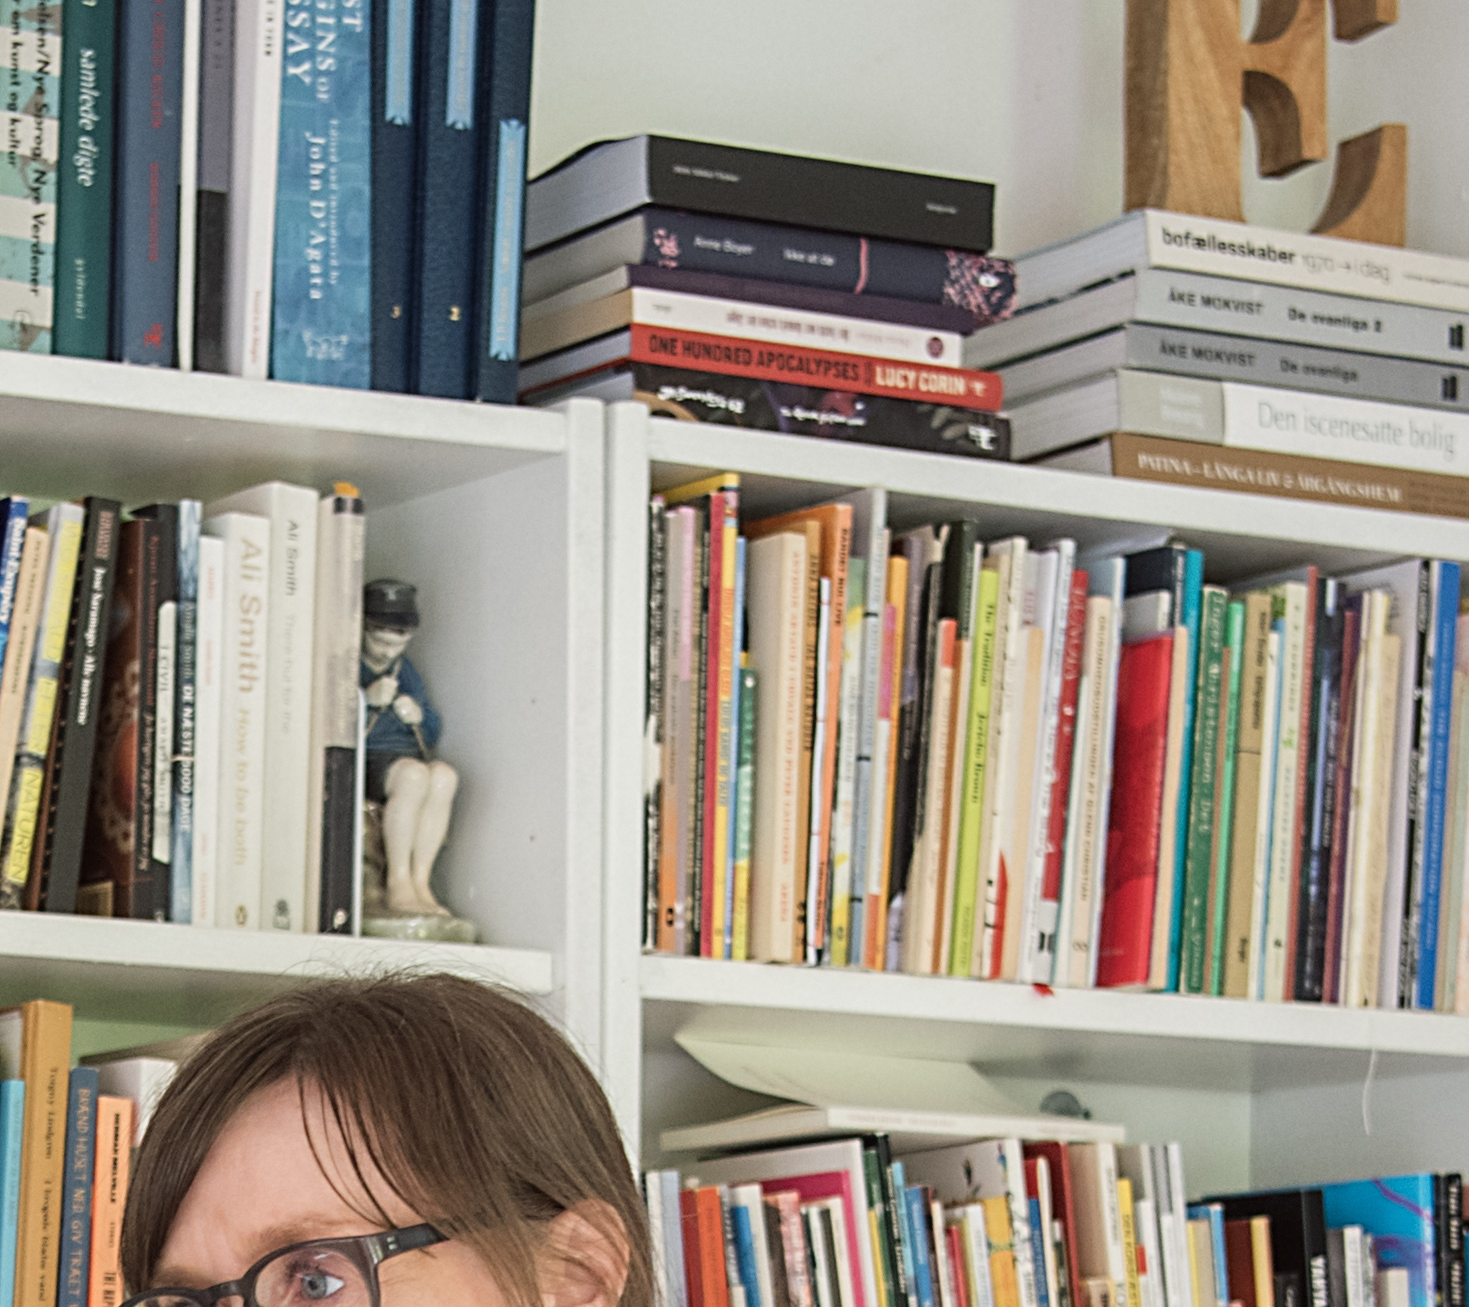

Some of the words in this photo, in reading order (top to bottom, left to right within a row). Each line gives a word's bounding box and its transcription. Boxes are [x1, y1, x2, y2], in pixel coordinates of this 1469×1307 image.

[1162, 228, 1295, 264] bofællesskaber
[649, 335, 676, 354] ONE
[678, 335, 752, 365] HUNDRED
[756, 346, 859, 383] APOCALYPSES
[875, 362, 913, 388] LUCY
[918, 367, 964, 395] CORIN
[1258, 403, 1296, 429] Den
[1303, 410, 1404, 442] iscenesatte
[1410, 422, 1454, 460] bolig
